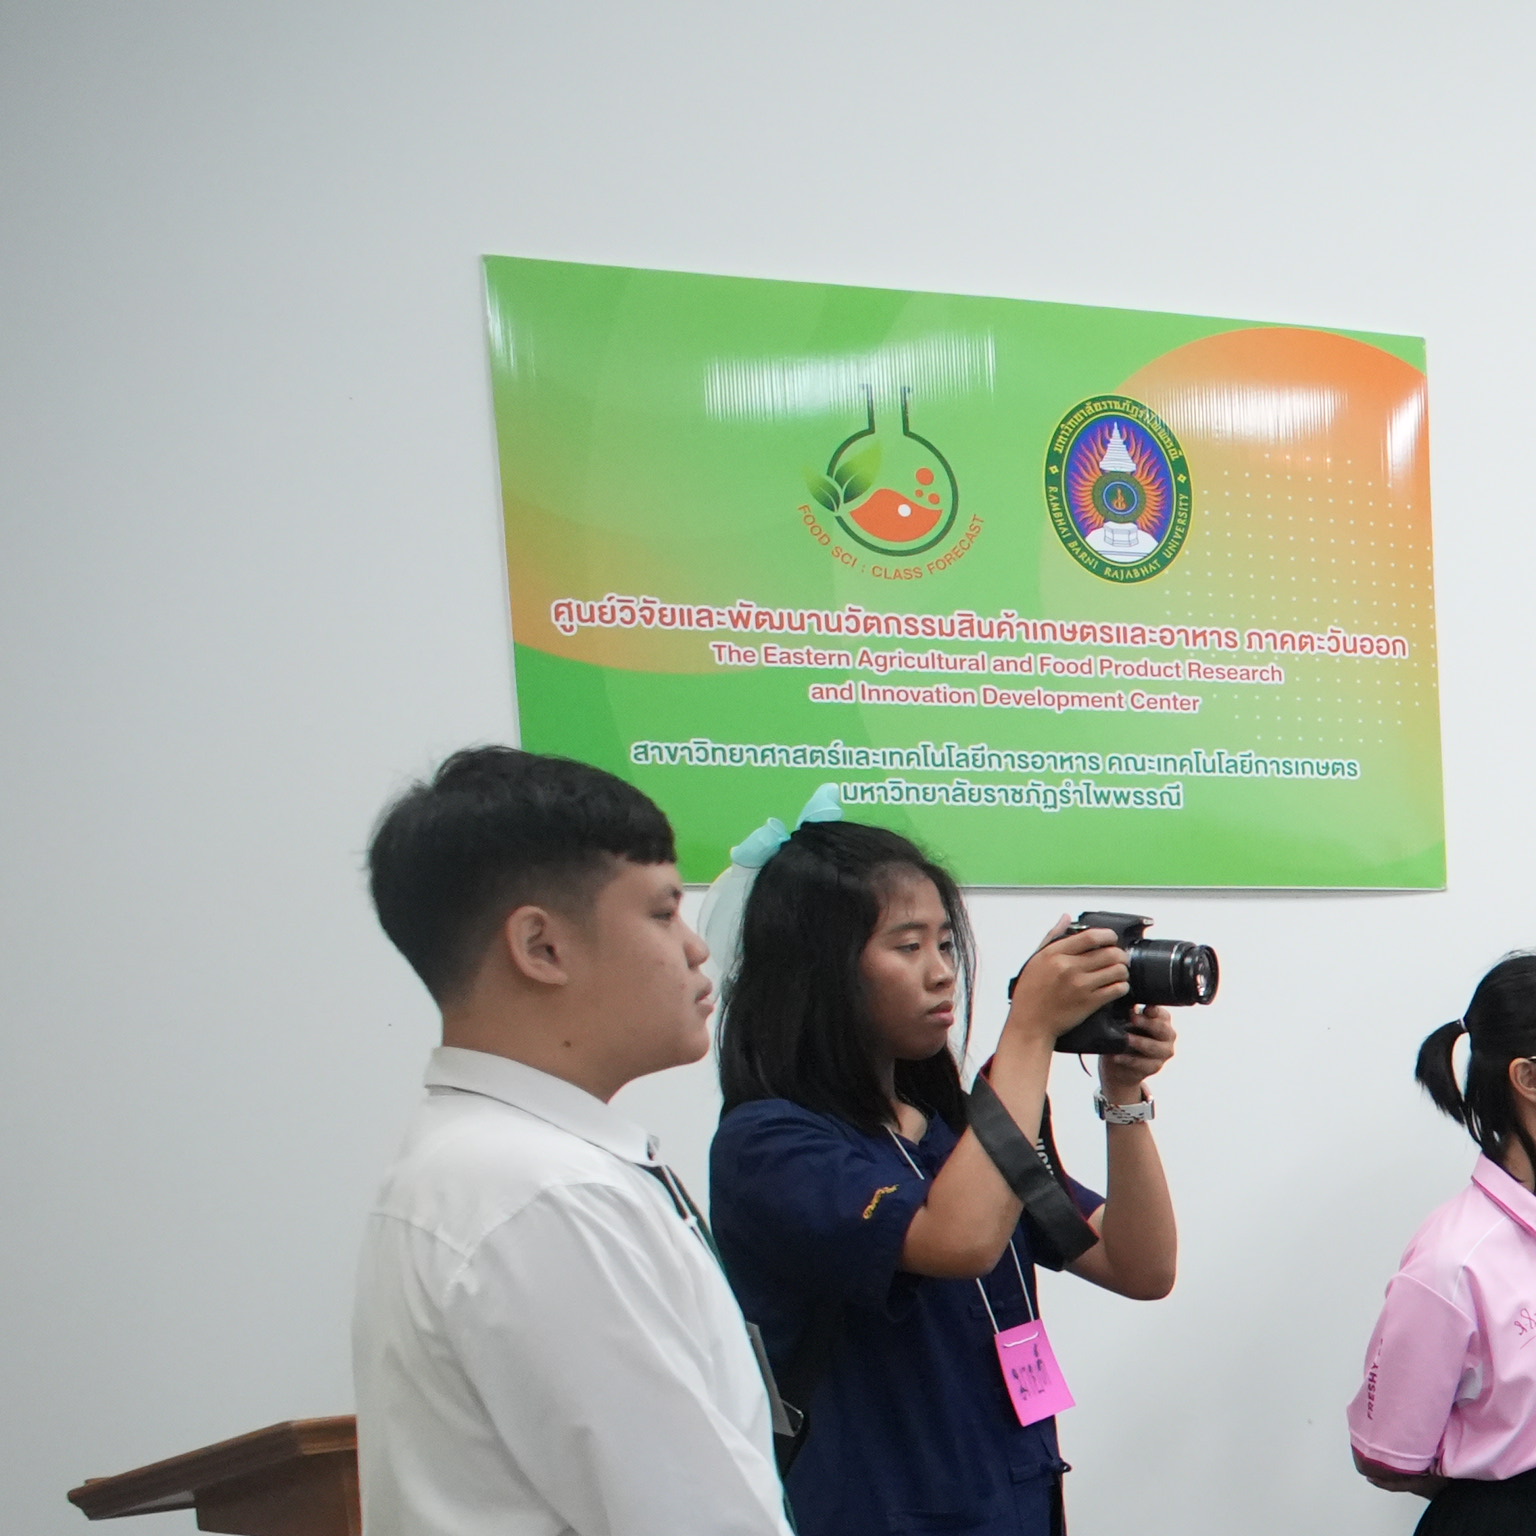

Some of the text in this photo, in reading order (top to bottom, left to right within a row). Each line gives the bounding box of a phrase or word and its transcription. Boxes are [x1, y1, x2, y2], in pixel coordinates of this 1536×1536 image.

[797, 503, 832, 547] FOOD
[831, 546, 859, 568] SCI
[871, 565, 924, 581] CLASS
[926, 513, 986, 575] FORECAST
[1047, 486, 1190, 582] RAMBHAI BARNI RAJABHAT UNIVERSITY
[552, 595, 1407, 659] ศูนย์วิจัยและพัฒนานวัตกรรมสินค้าเกษตรและอาหาร ภาคตะวันออก
[712, 643, 1284, 682] The Eastern Agricultural and Food Product Research
[811, 683, 1200, 712] and Innovation Development Center
[632, 740, 1359, 777] สาขาวิทยาศาสตร์และเทคโนโลยีการอาหาร คณะเทคโนโลยีการเกษตร
[842, 780, 1182, 811] มหาวิทยาลัยราชภัฏรำไพพรรณี
